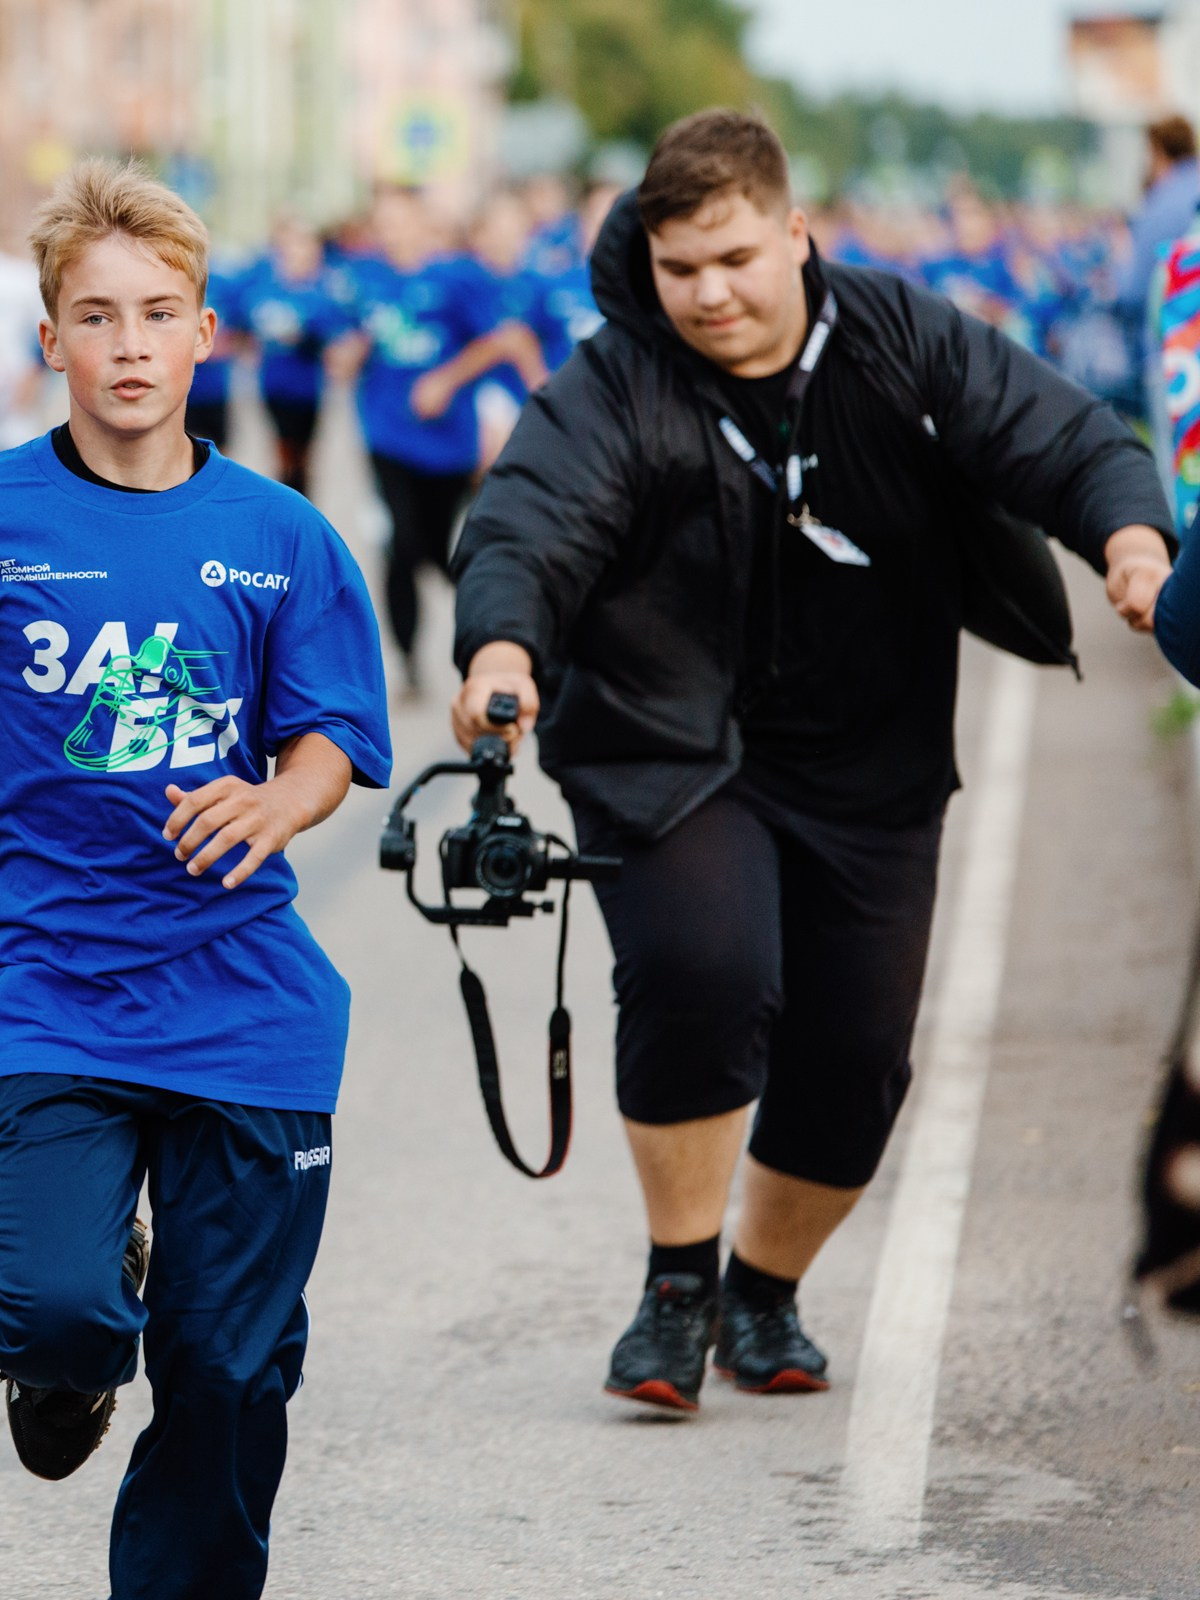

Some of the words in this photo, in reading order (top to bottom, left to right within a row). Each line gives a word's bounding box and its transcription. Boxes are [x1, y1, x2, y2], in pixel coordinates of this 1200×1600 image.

[0, 563, 51, 575] АТОМНОЙ
[1, 571, 108, 583] ПРОМЫШЛЕННОСТИ
[21, 619, 179, 696] ЗА!
[294, 1145, 331, 1171] RUSSIA
